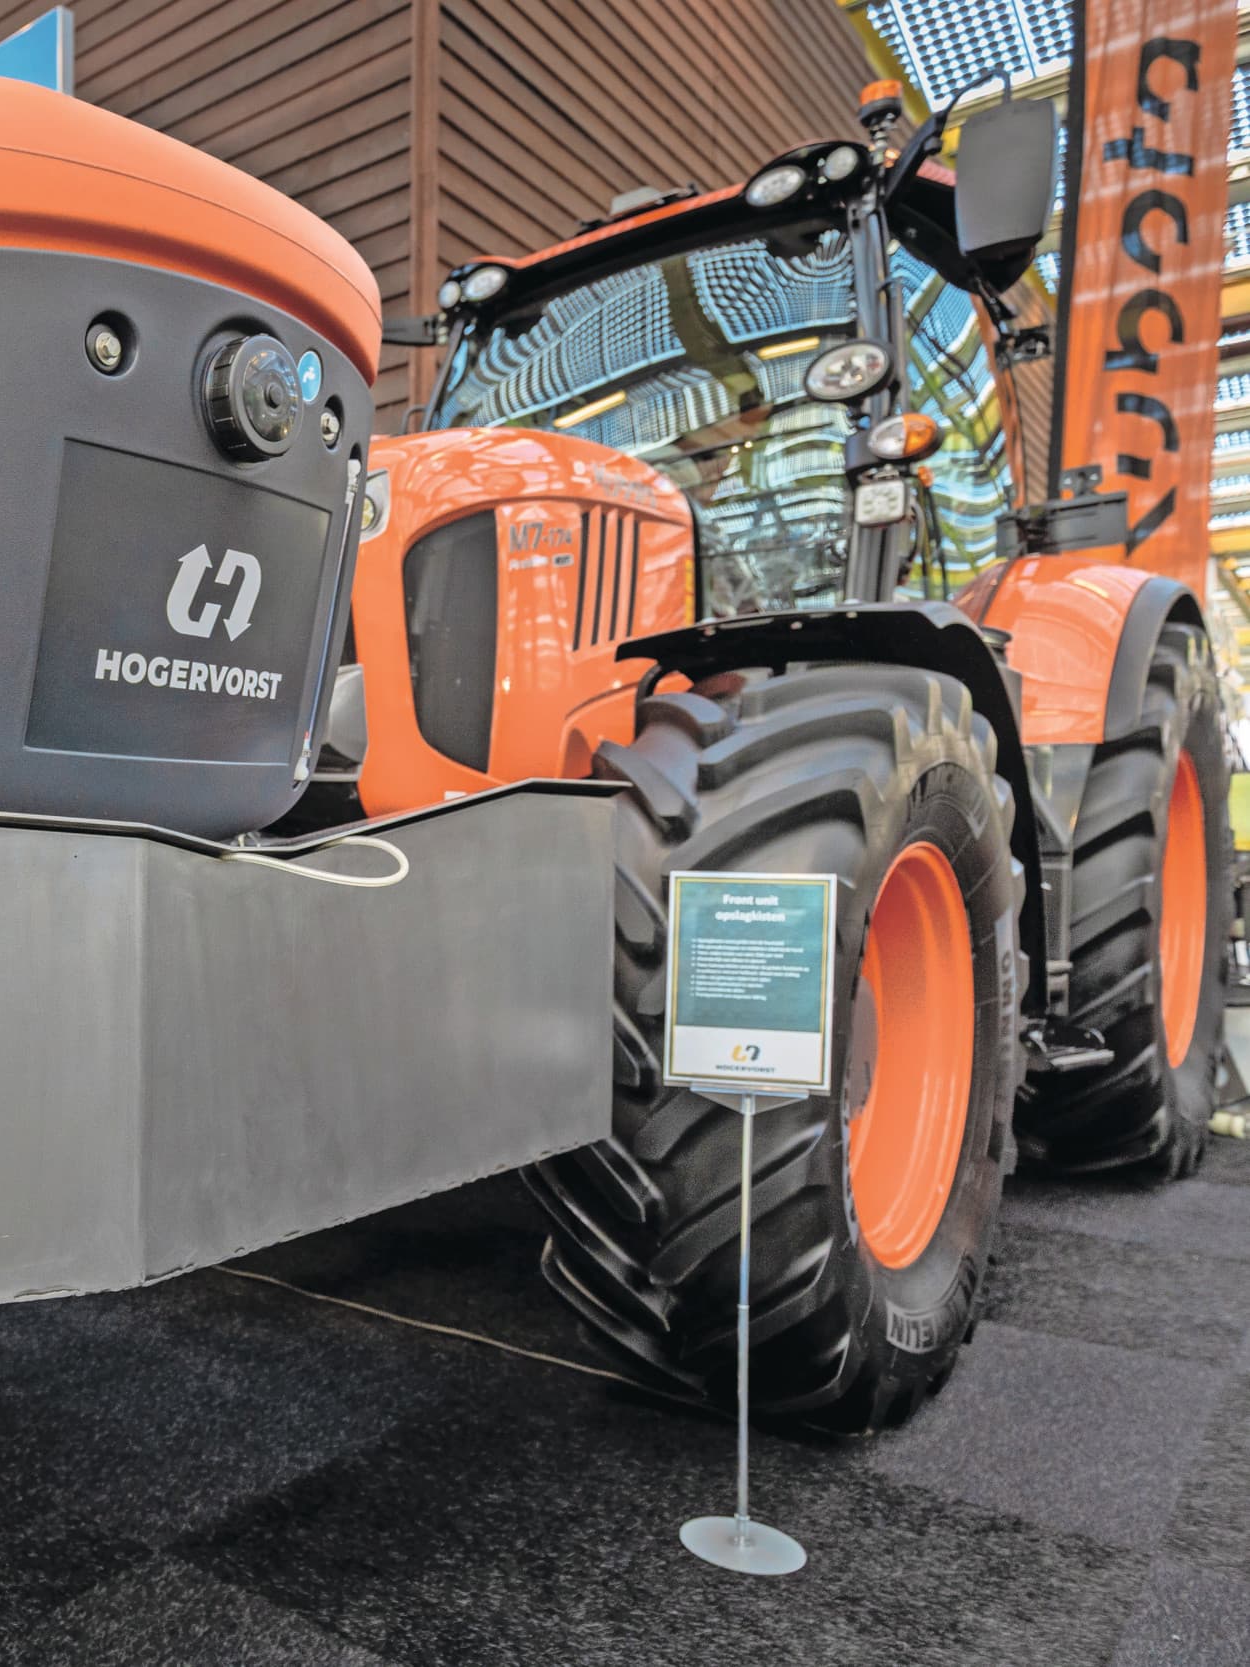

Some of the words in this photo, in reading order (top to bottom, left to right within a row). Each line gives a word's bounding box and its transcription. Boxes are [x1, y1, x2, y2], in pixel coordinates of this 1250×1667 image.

[95, 648, 282, 700] HOGERVORST
[722, 894, 754, 905] Front
[755, 895, 778, 906] unit
